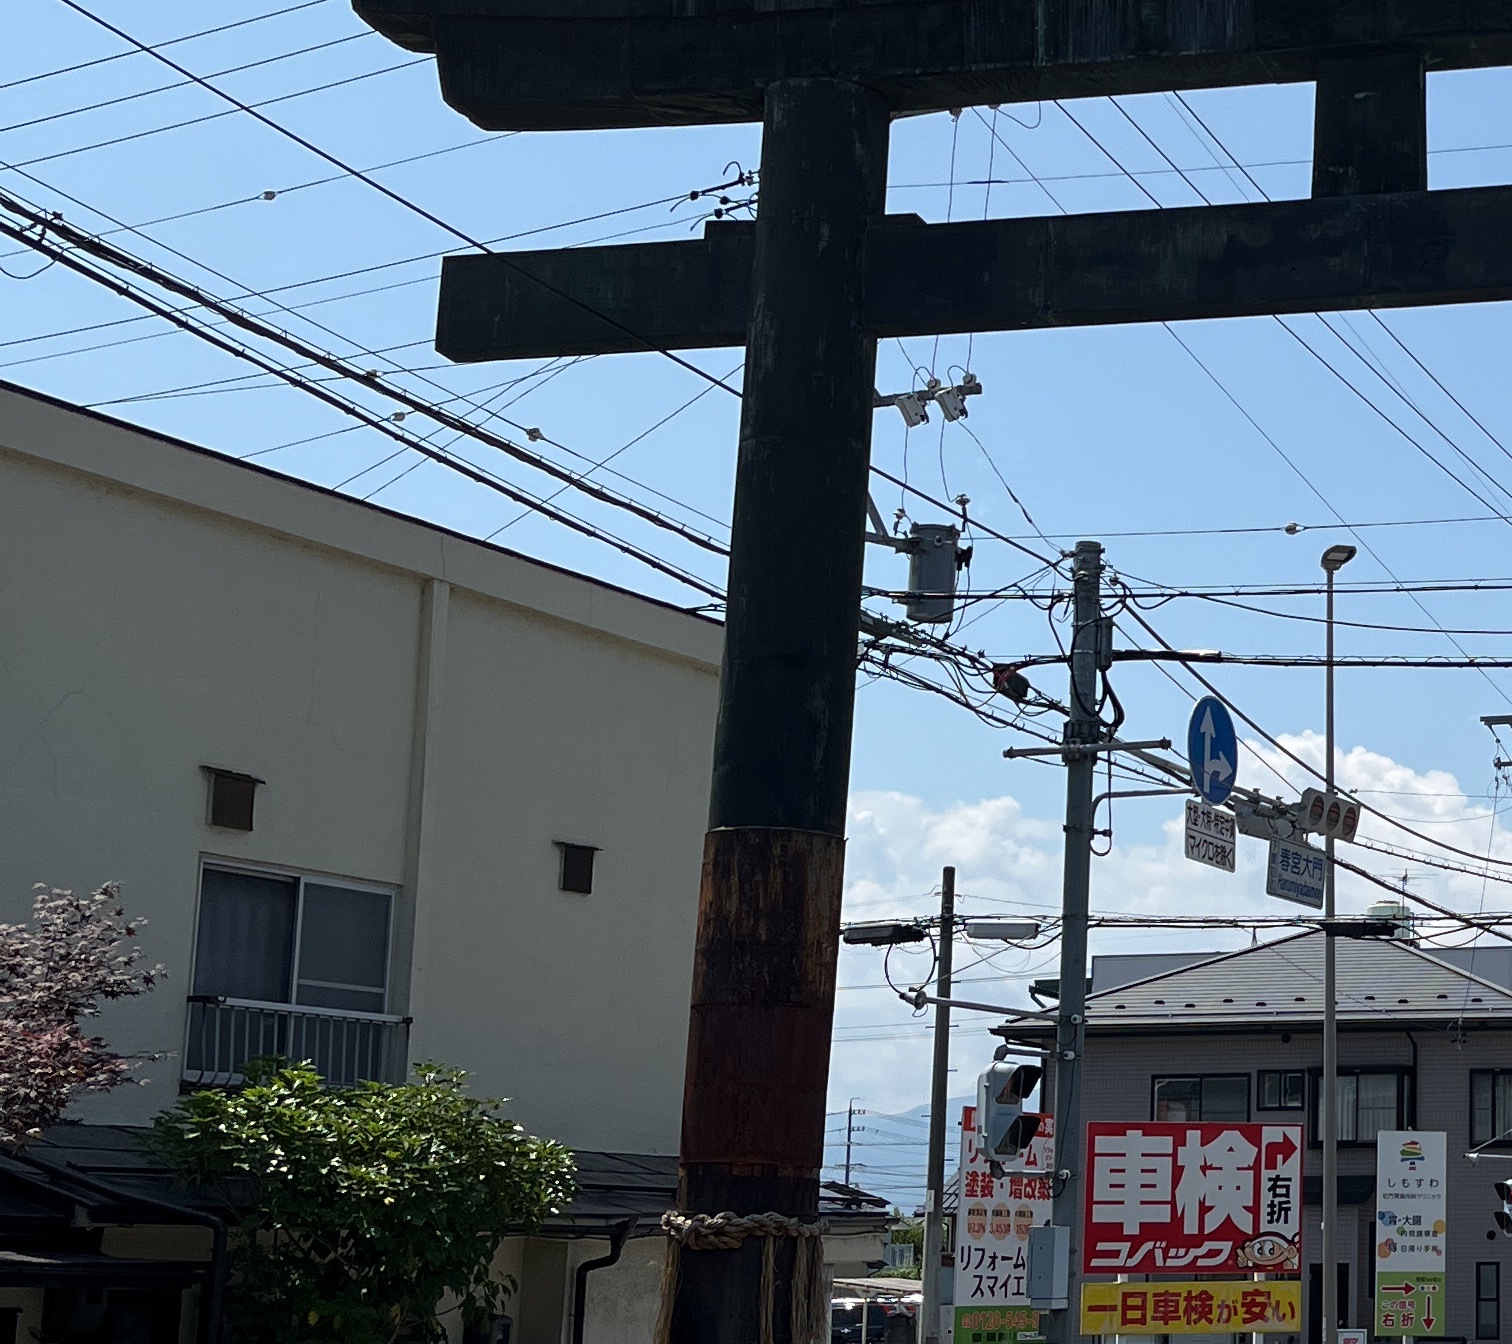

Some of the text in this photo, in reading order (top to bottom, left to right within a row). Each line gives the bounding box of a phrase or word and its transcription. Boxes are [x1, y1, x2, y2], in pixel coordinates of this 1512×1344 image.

[1279, 847, 1324, 882] 春宮大門
[1092, 1129, 1259, 1235] 車検
[1387, 1177, 1439, 1189] しもすわ
[1266, 1174, 1293, 1225] 右折
[960, 1245, 1026, 1272] リフォーム
[1089, 1240, 1234, 1267] コバック
[970, 1273, 1026, 1299] スマイエ
[1087, 1288, 1296, 1327] 一日車検が安い
[1382, 1312, 1415, 1327] 右折
